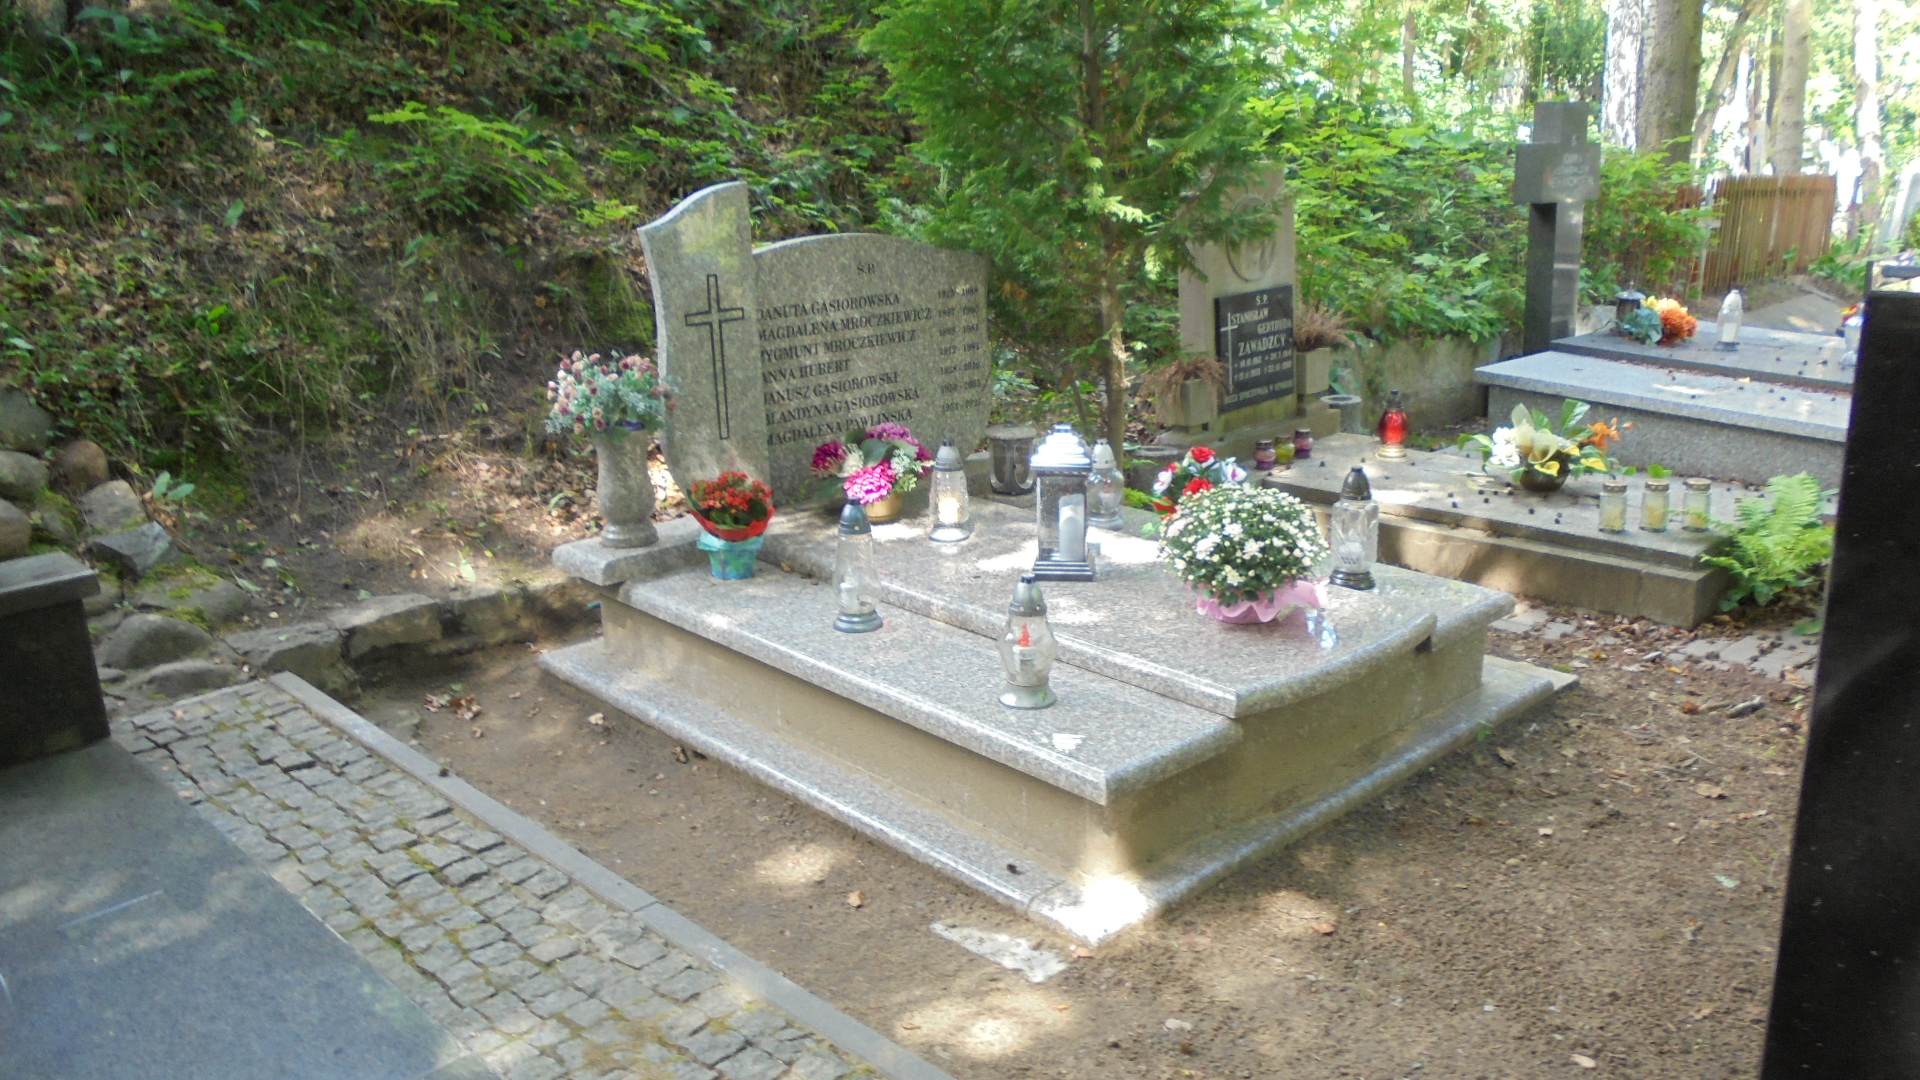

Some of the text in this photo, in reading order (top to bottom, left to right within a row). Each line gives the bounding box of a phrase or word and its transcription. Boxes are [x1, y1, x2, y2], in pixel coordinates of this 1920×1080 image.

[811, 294, 900, 317] GĄSIOROWSKA
[840, 307, 932, 329] MROCZKIEWICZ
[824, 329, 916, 353] MROCZKIEWICZ
[1238, 333, 1287, 356] ZAWADZCY
[799, 359, 851, 378] HUBERT
[813, 371, 899, 398] GĄSIOROWSKI
